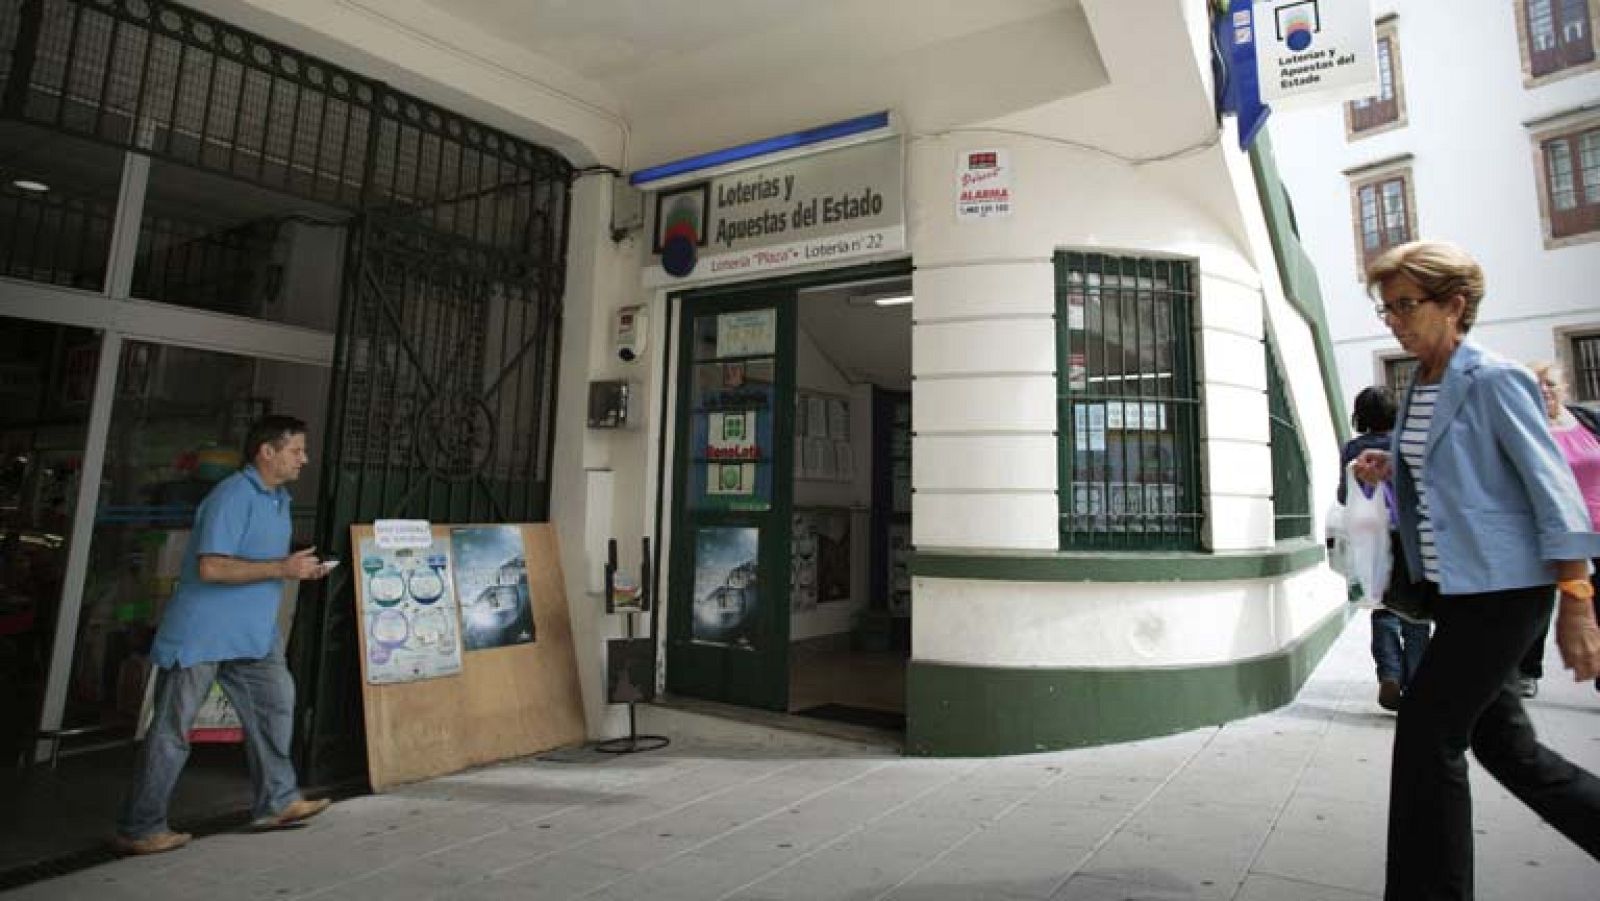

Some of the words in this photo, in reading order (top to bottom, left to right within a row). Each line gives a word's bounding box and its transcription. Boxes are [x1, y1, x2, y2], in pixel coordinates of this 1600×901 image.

[1329, 49, 1336, 58] y
[1281, 60, 1334, 77] Apuestas
[1337, 53, 1355, 66] del
[1281, 73, 1320, 88] Estado
[784, 174, 795, 200] y
[960, 188, 1009, 201] ALARMA
[715, 209, 787, 247] Apuestas
[792, 198, 817, 229] del
[823, 187, 883, 224] Estado
[866, 233, 884, 249] 22
